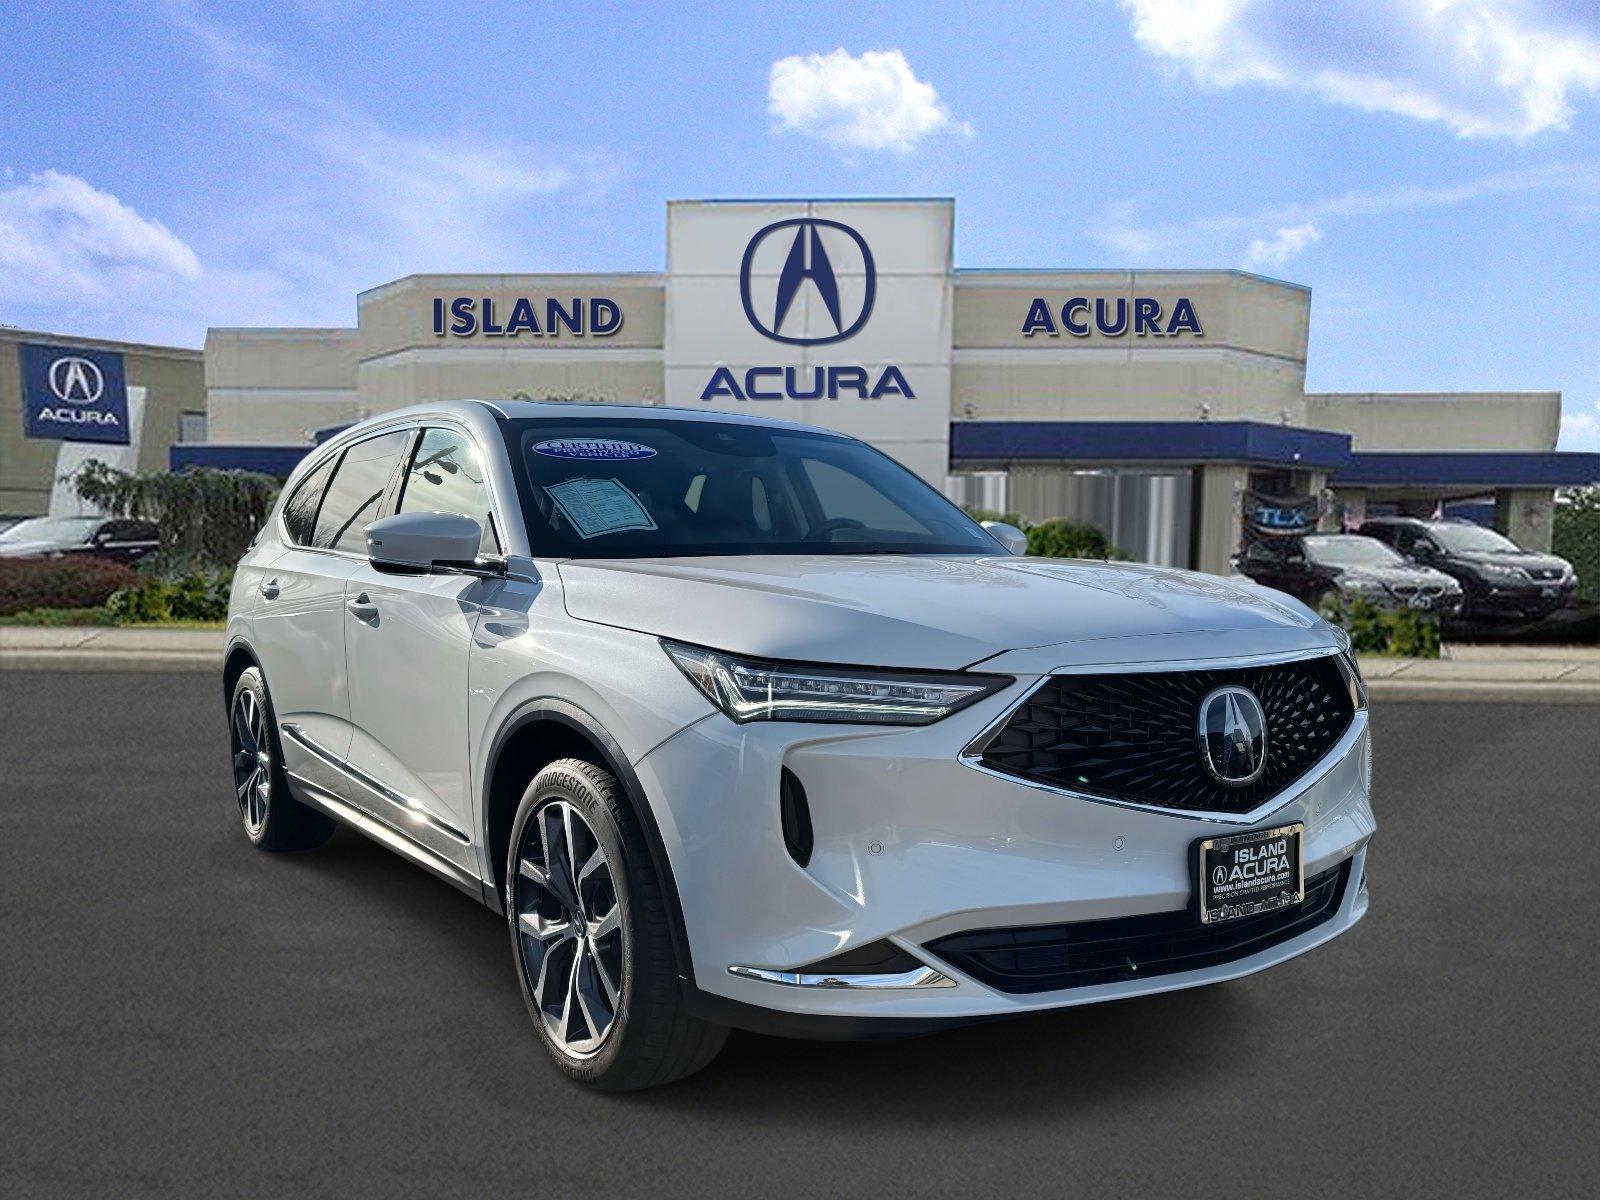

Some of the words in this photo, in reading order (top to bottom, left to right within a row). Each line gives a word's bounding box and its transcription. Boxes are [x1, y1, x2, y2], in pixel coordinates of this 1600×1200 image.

[433, 297, 623, 336] ISLAND
[1021, 297, 1204, 337] ACURA
[699, 365, 916, 400] ACURA
[39, 407, 119, 425] ACURA
[546, 442, 643, 451] CERTIFIED
[1257, 508, 1305, 525] TLX
[1234, 840, 1287, 864] ISLAND
[1229, 854, 1290, 882] ACURA
[1213, 871, 1290, 893] www.islandacura.com
